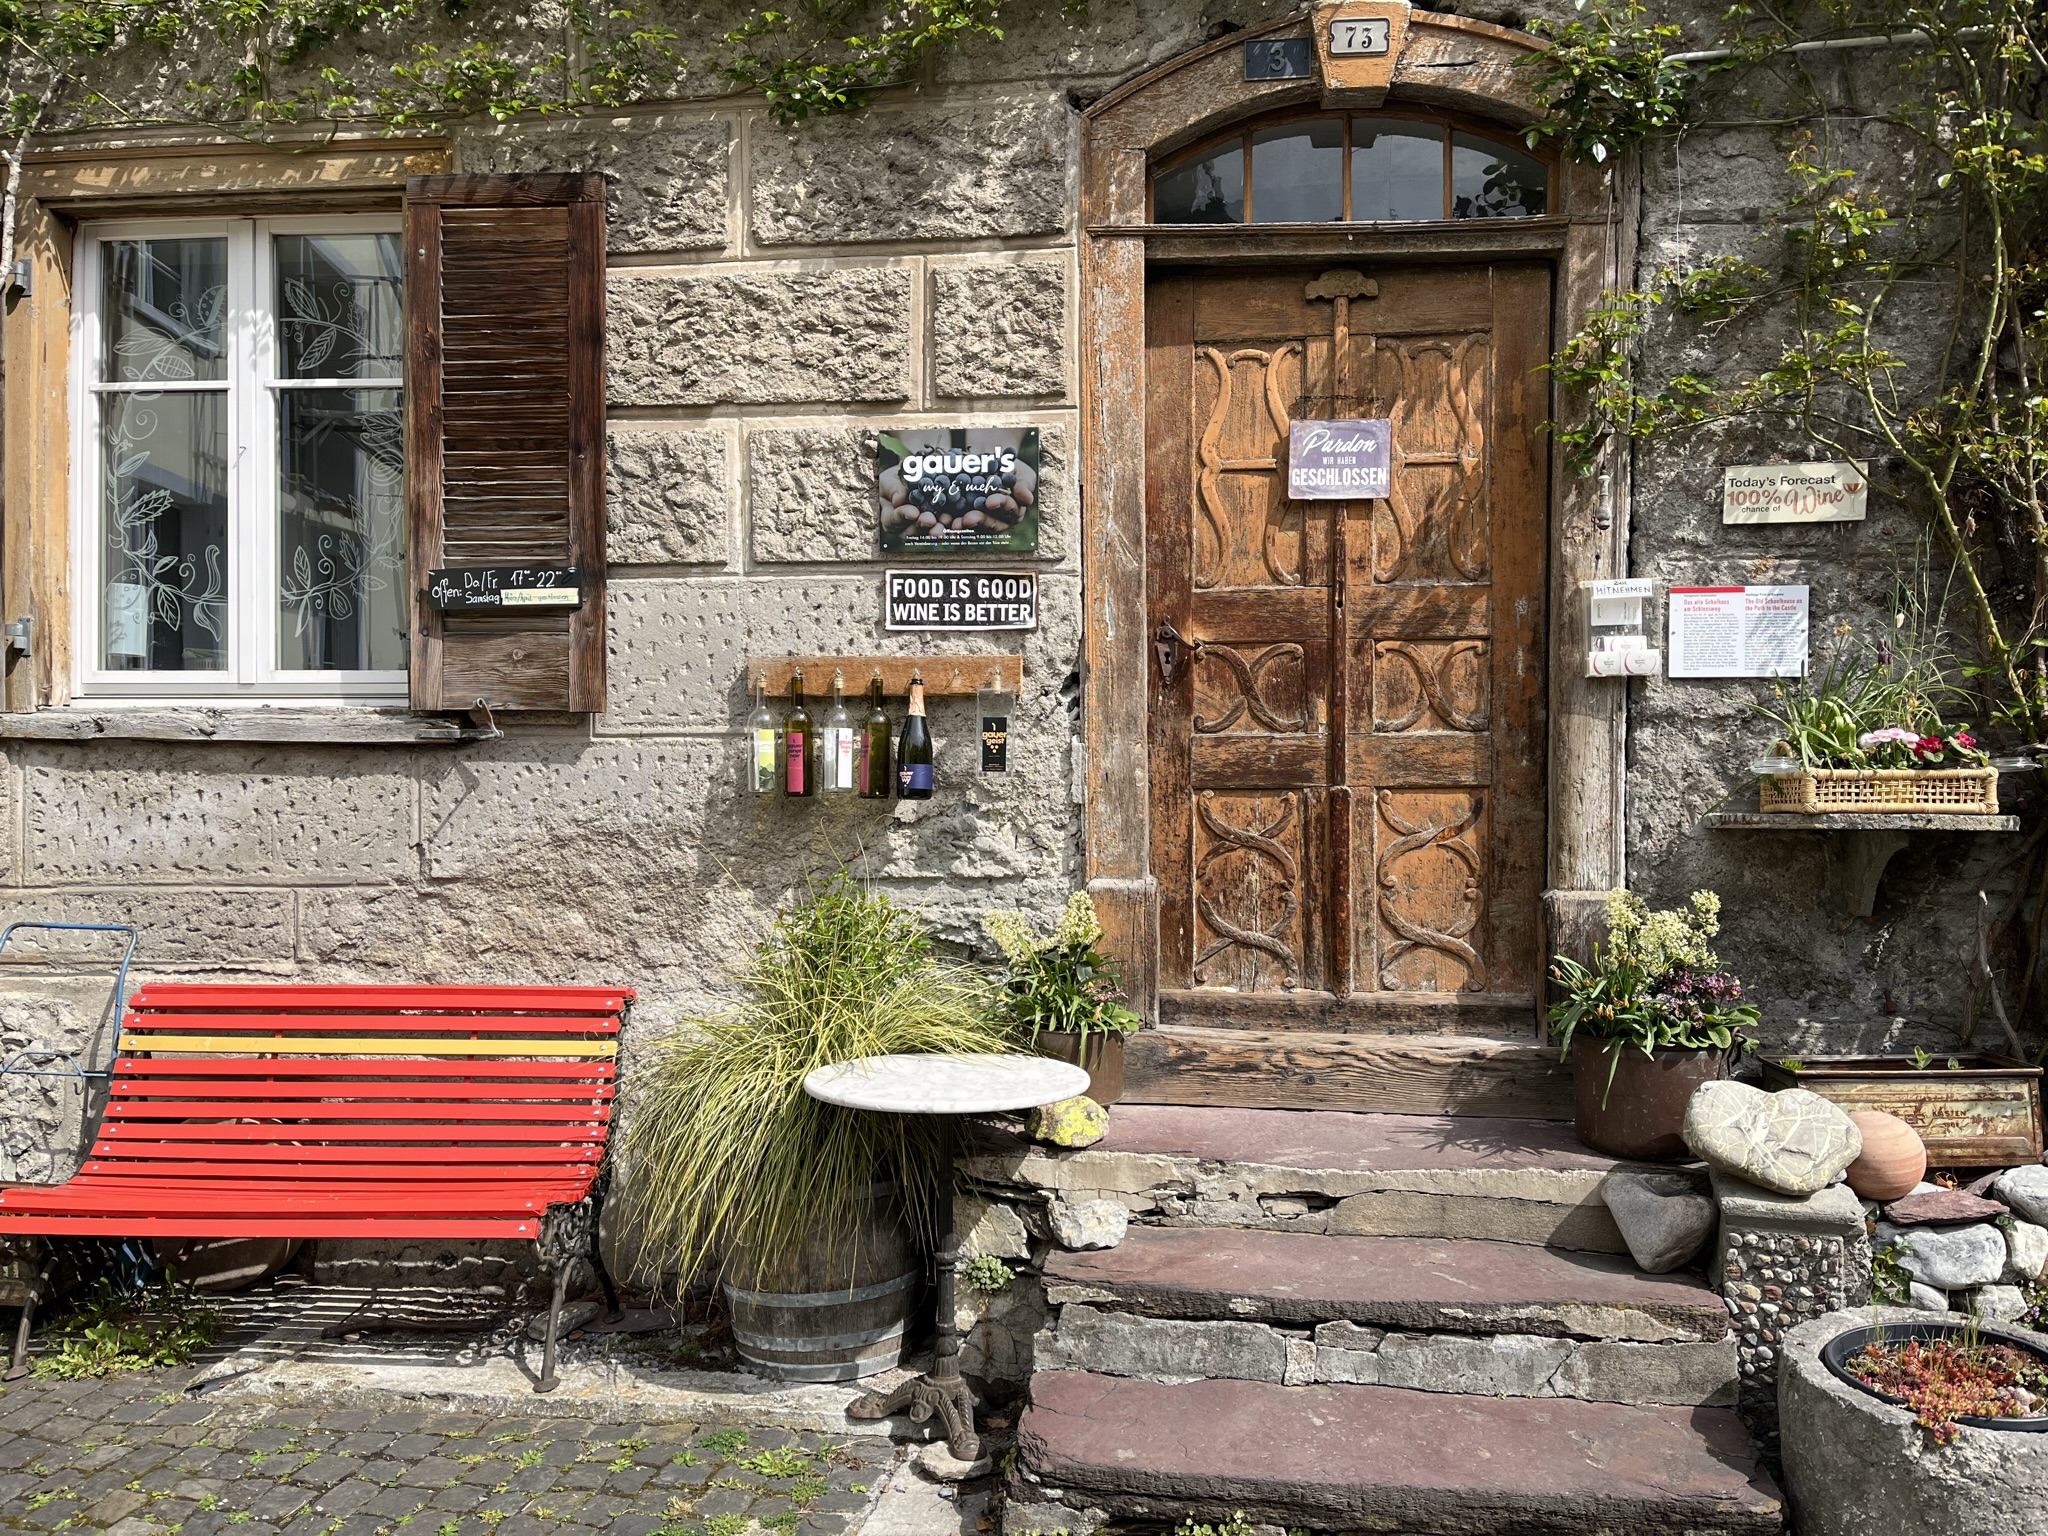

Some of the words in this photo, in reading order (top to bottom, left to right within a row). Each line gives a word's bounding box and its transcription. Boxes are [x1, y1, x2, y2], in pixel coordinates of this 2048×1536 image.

[1345, 26, 1373, 49] 73
[1269, 46, 1286, 71] 3
[1302, 429, 1377, 456] Pardon
[903, 446, 1015, 482] gauer's
[1322, 456, 1334, 464] WIR
[1336, 456, 1356, 464] HABEN
[1292, 468, 1386, 486] GESCHLOSSEN
[1729, 477, 1776, 488] Today's
[1780, 474, 1836, 486] Forecast
[922, 482, 945, 503] wy
[949, 481, 960, 497] &
[1726, 488, 1782, 506] 100%
[1784, 486, 1844, 516] Wine
[465, 590, 500, 604] Samstag
[892, 579, 944, 598] FOOD
[950, 578, 970, 598] IS
[978, 578, 1031, 599] GOOD
[893, 603, 940, 622] WINE
[943, 603, 960, 621] IS
[964, 603, 1031, 622] BETTER
